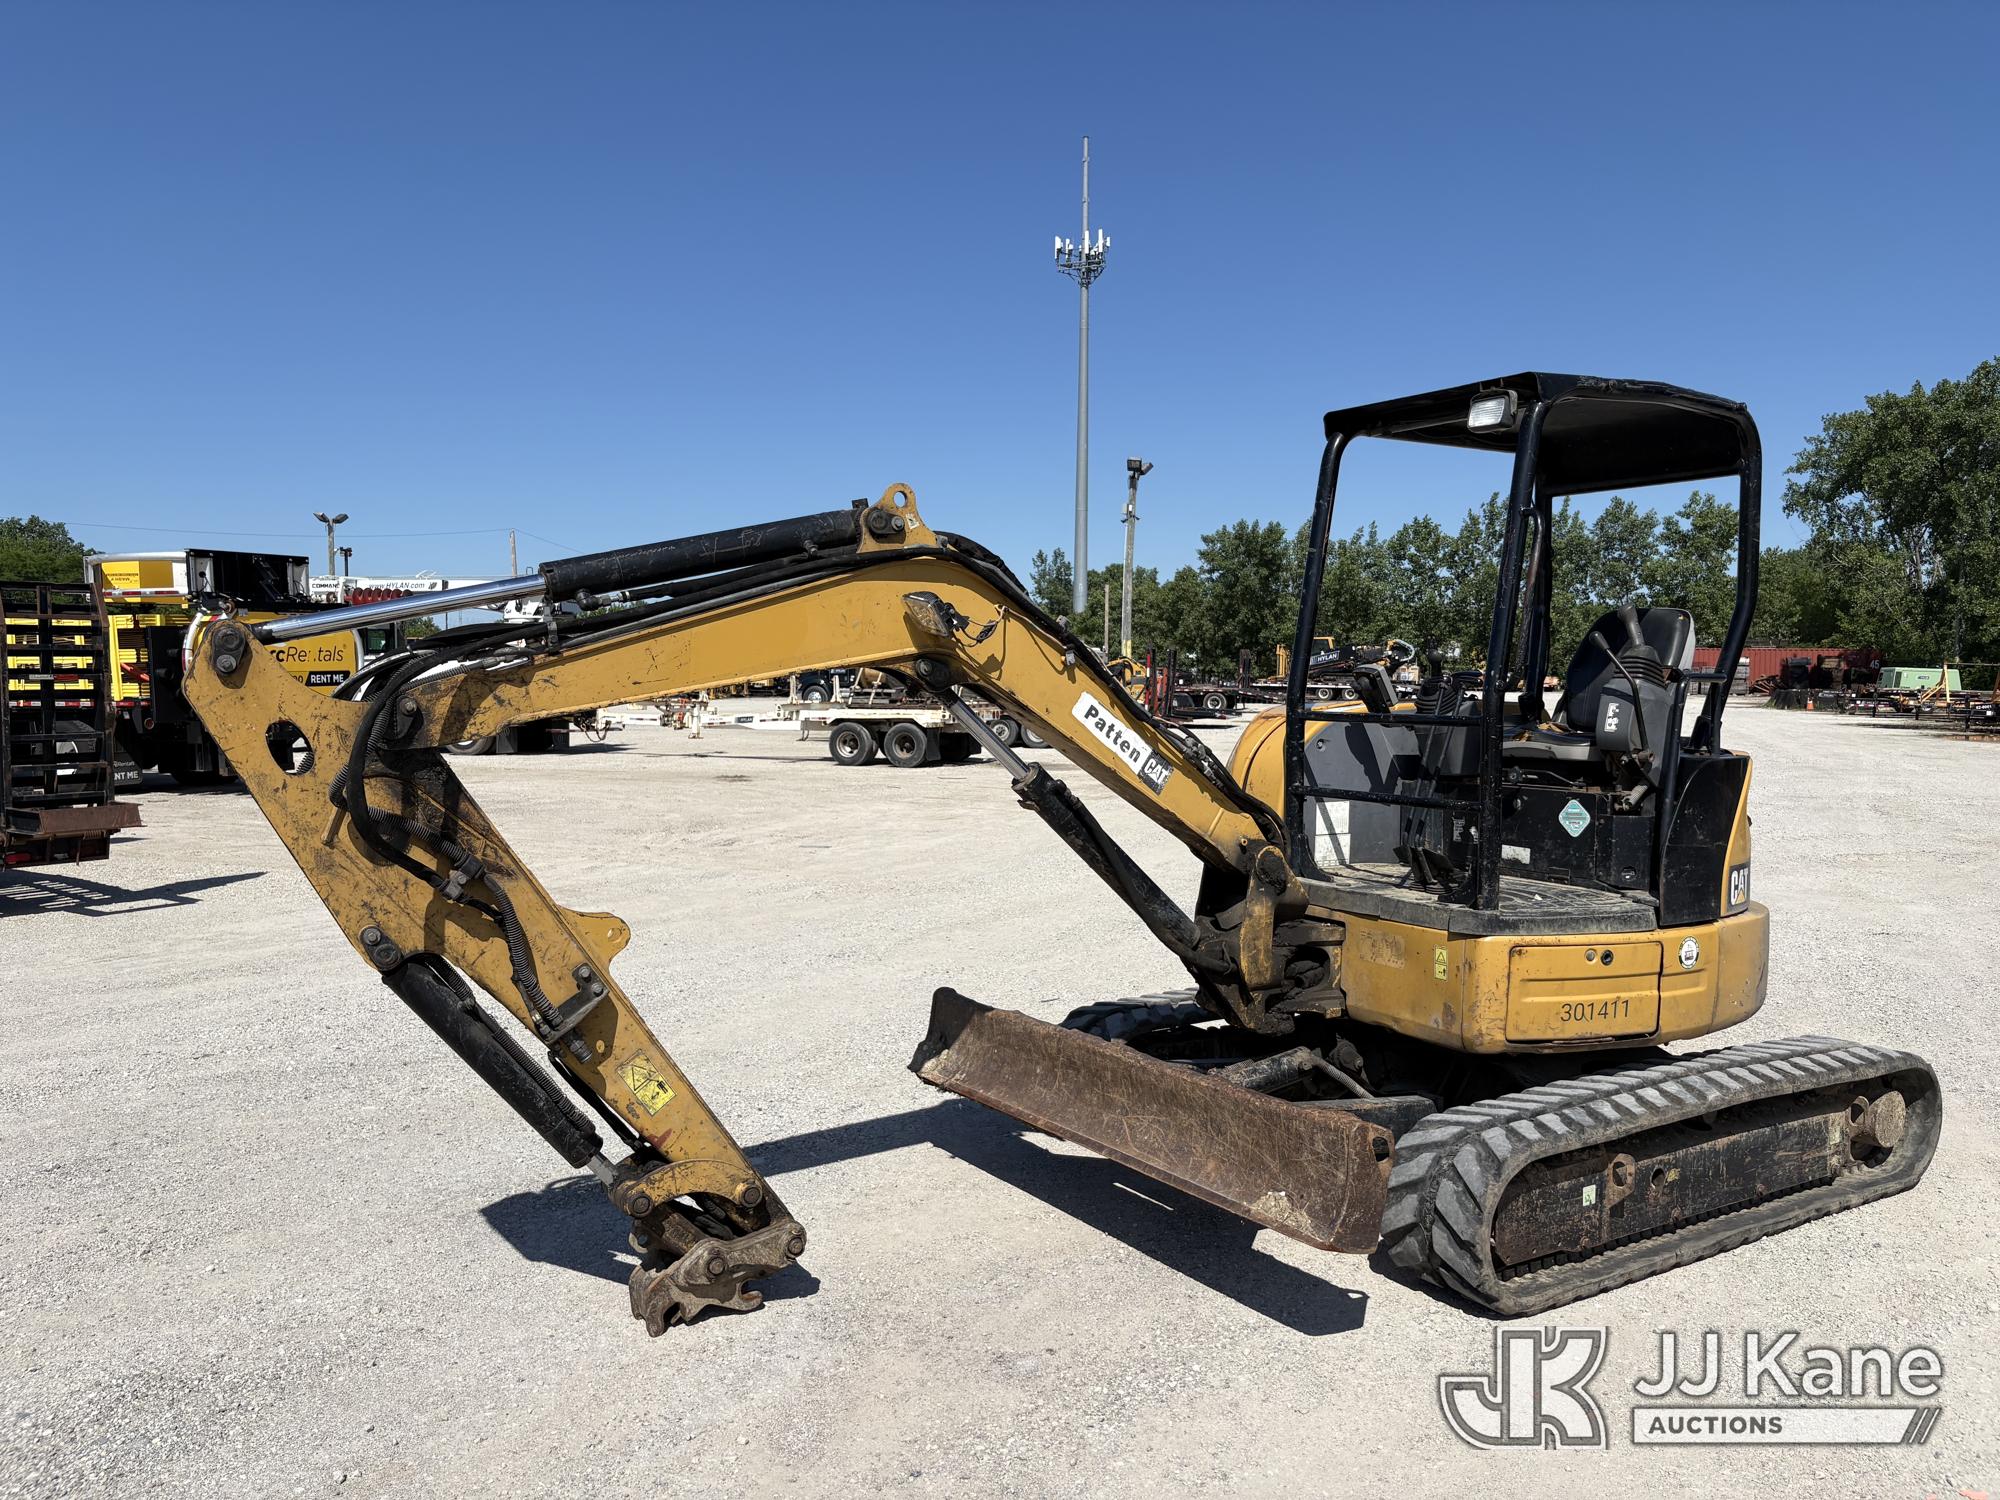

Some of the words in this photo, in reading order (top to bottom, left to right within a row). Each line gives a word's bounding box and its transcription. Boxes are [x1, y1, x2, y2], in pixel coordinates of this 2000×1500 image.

[368, 581, 425, 589] www.HYLAN.com
[1317, 652, 1337, 662] HYLAN
[310, 674, 331, 684] RENT
[333, 674, 344, 683] ME
[1084, 704, 1141, 763] Patten
[1144, 758, 1170, 784] CAT
[113, 772, 126, 781] NT
[127, 770, 139, 779] ME
[1730, 867, 1749, 906] CAT
[1560, 1000, 1629, 1022] 301411
